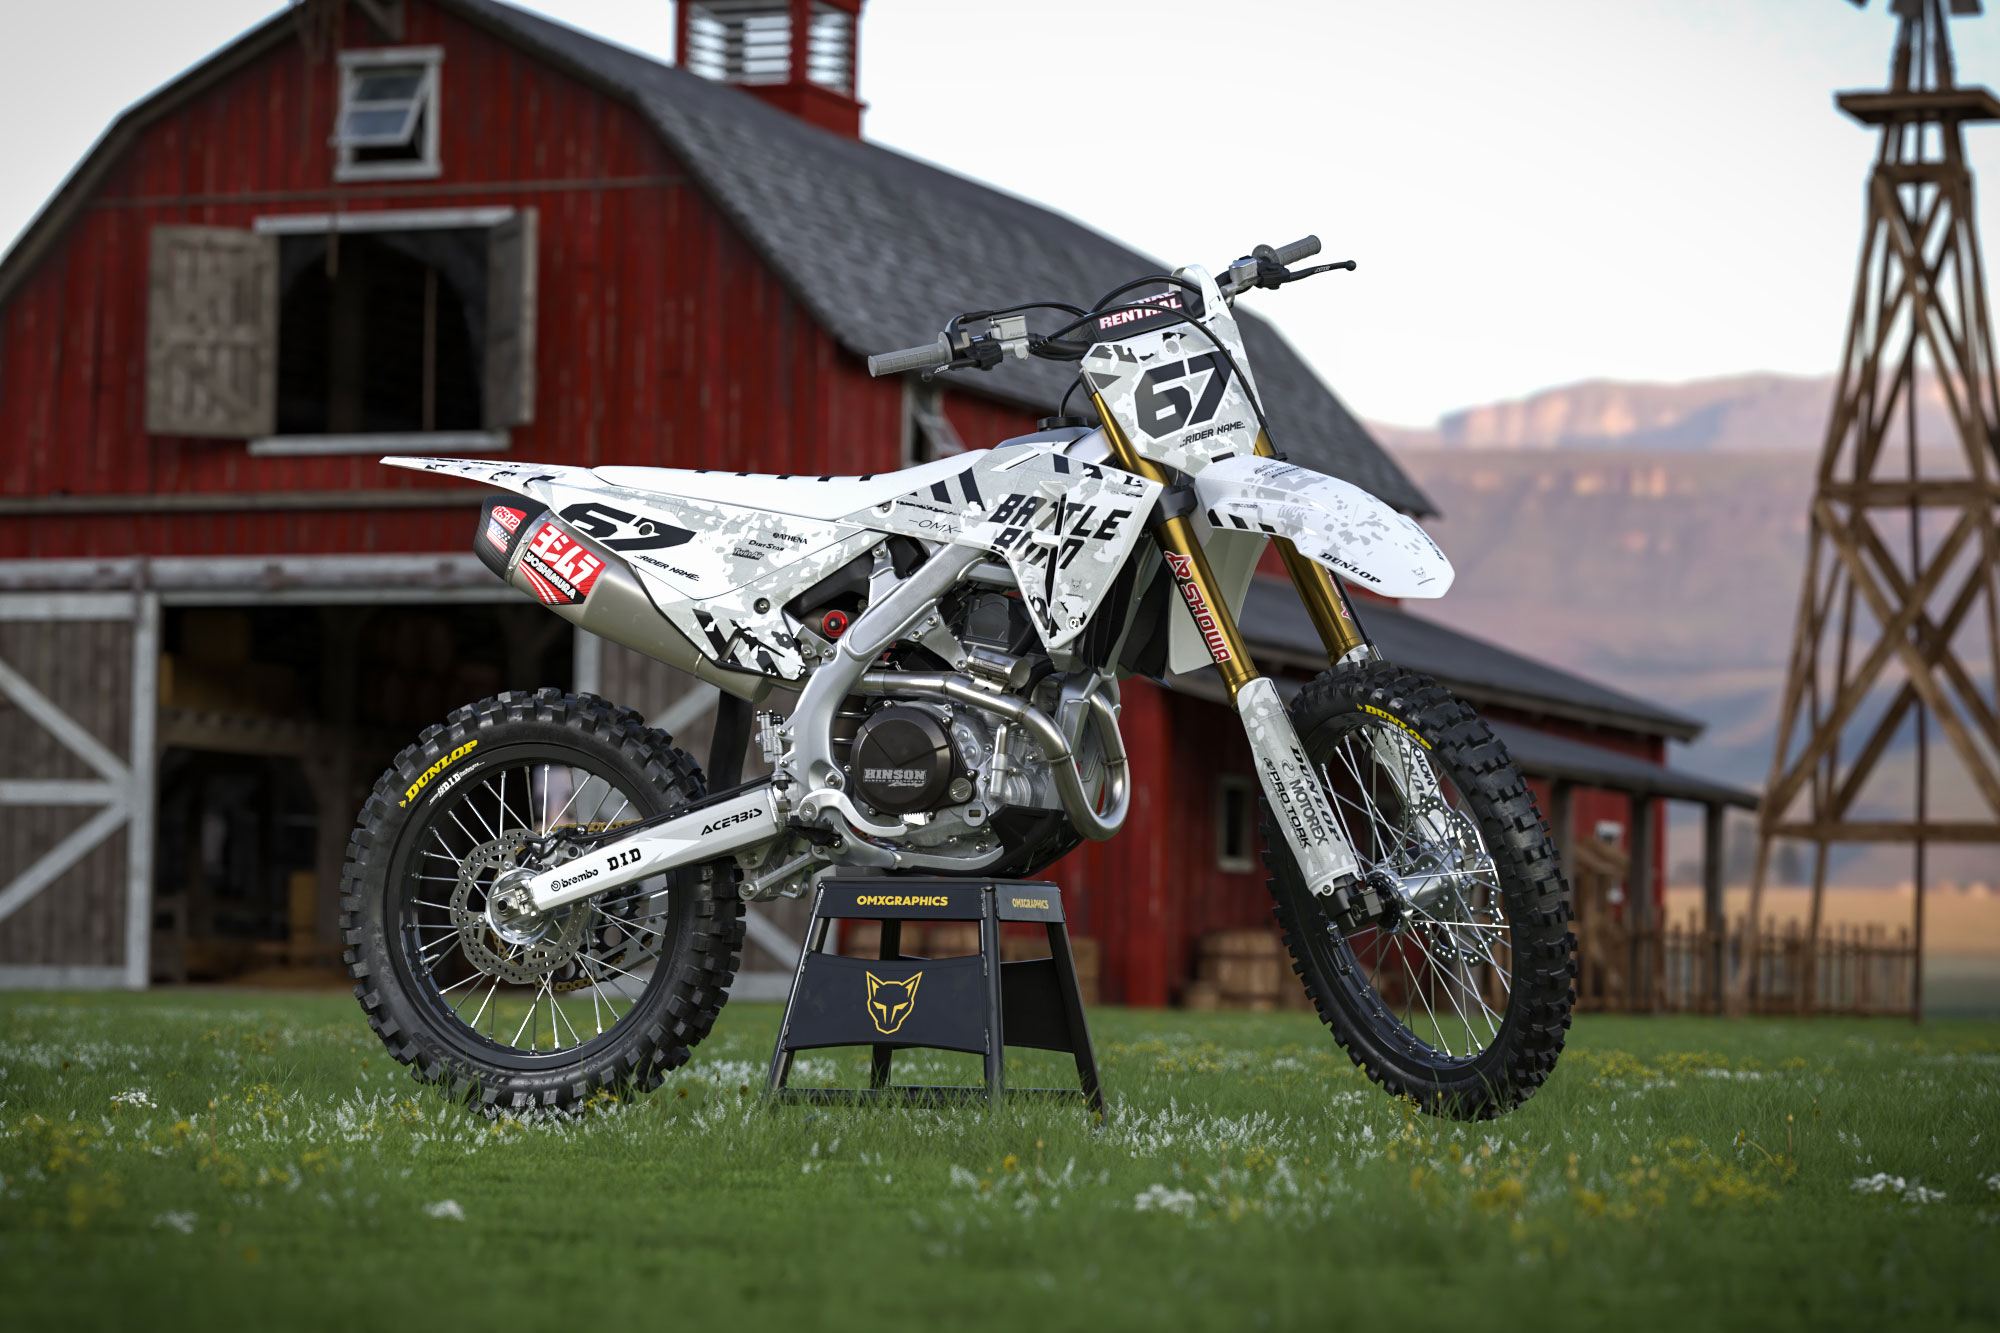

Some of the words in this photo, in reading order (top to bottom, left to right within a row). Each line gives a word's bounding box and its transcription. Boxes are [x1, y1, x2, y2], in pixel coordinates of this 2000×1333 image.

[1134, 349, 1233, 439] 67
[558, 502, 697, 552] 67
[779, 533, 807, 545] ATHENA
[523, 551, 577, 600] YOSHIMURA
[529, 524, 601, 587] ヨシムラ
[1319, 552, 1382, 584] DUNLOP
[1180, 582, 1232, 663] SHOWA
[1364, 704, 1432, 750] DUNLOP
[405, 739, 478, 802] DUNLOP
[864, 768, 926, 780] HINSON
[1290, 745, 1341, 842] DUNLOP
[1270, 770, 1291, 804] PRO
[1287, 805, 1312, 848] TORK
[1289, 779, 1329, 846] MOTOREX
[562, 868, 599, 888] brembo
[856, 895, 949, 907] OMXGRAPHICS
[1011, 897, 1049, 910] OMXGRAPHICS
